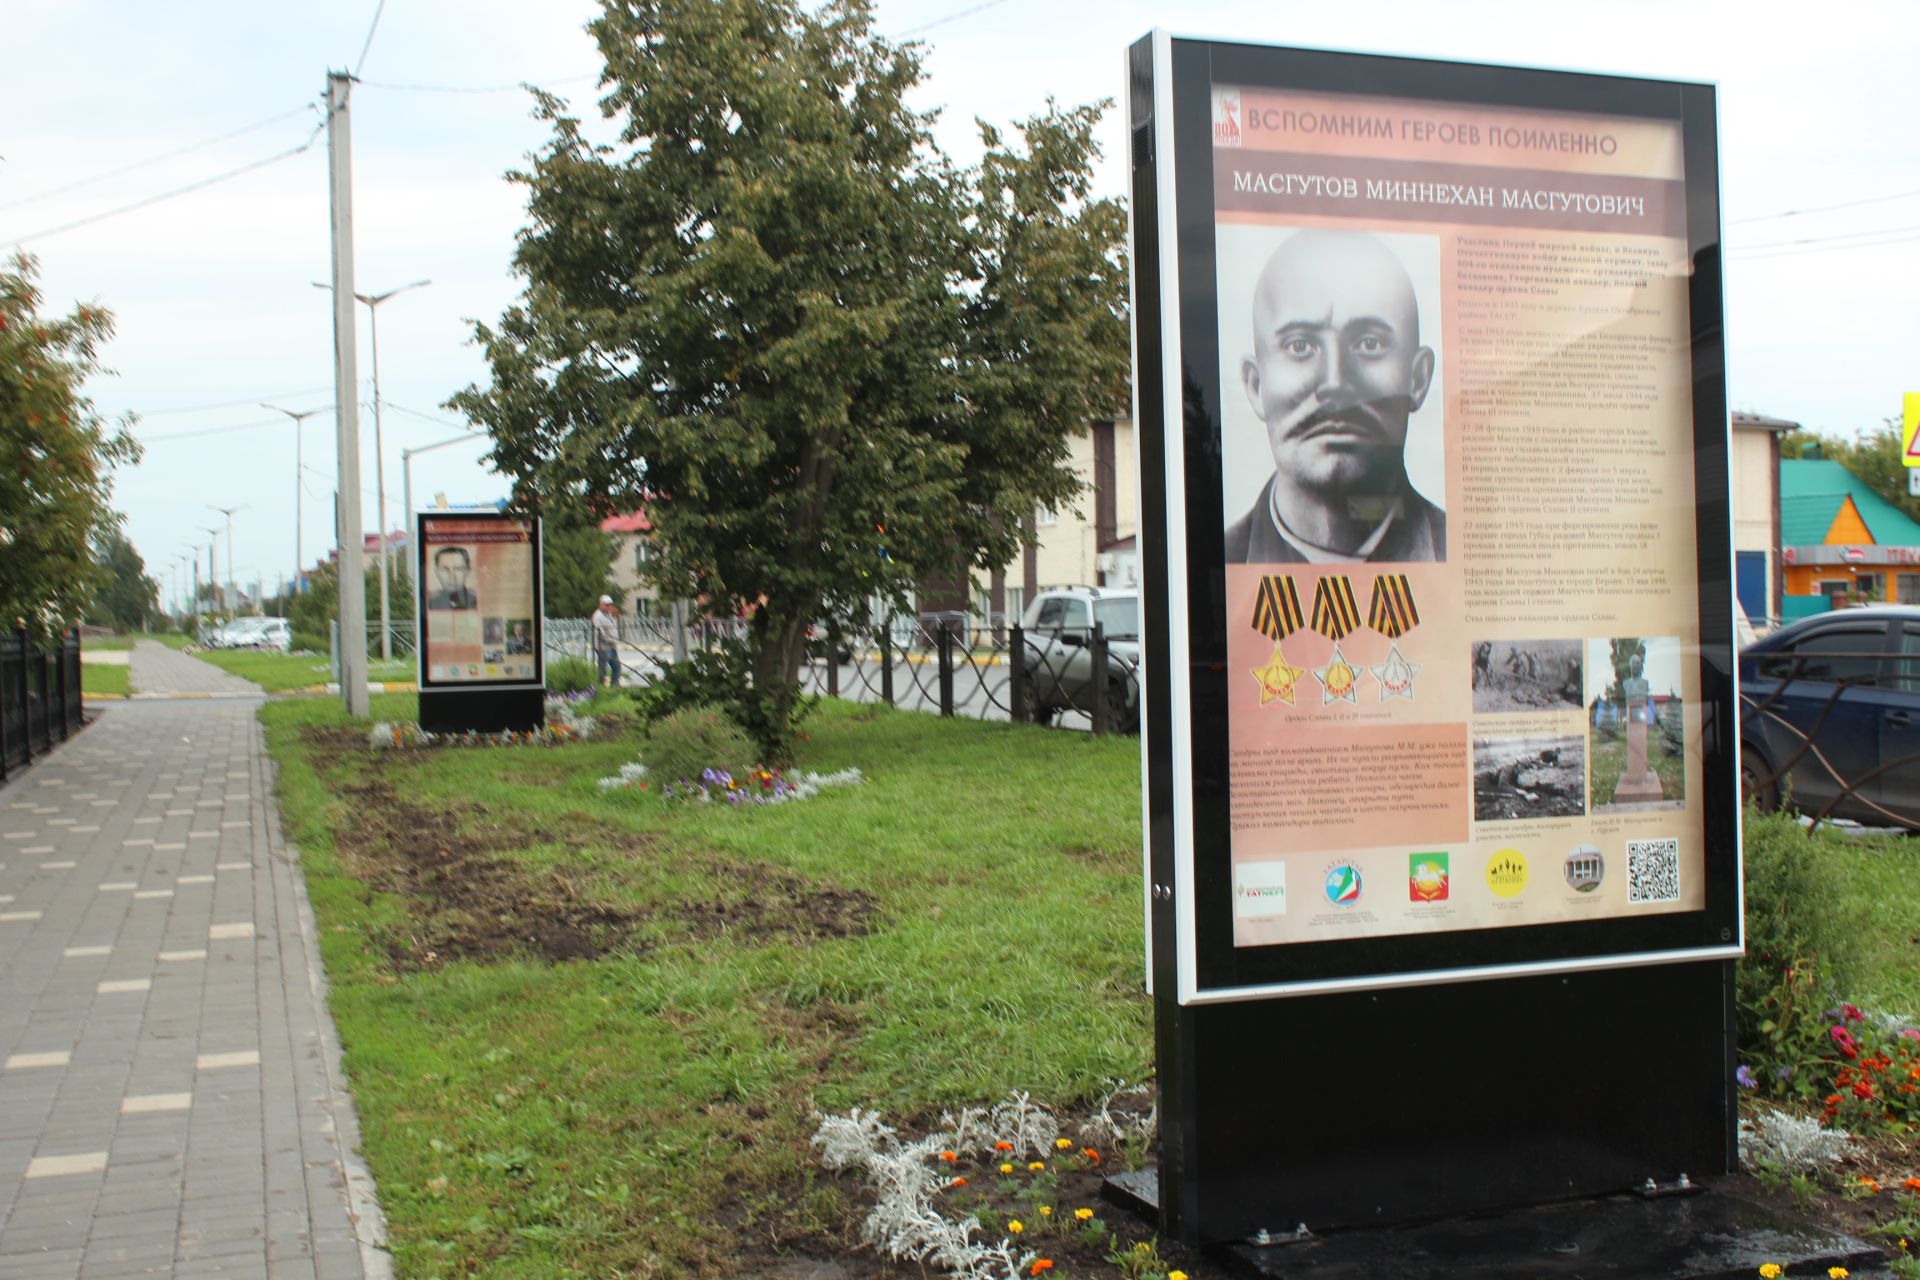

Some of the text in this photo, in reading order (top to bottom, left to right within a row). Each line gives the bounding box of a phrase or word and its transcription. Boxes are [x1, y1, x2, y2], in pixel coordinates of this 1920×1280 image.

[1249, 108, 1618, 156] ВСПОМНИМ ГЕРОЕВ ПОИМЕННО
[1233, 170, 1645, 217] МАСГУТОВ МИННЕХАН МАСГУТОВИЧ
